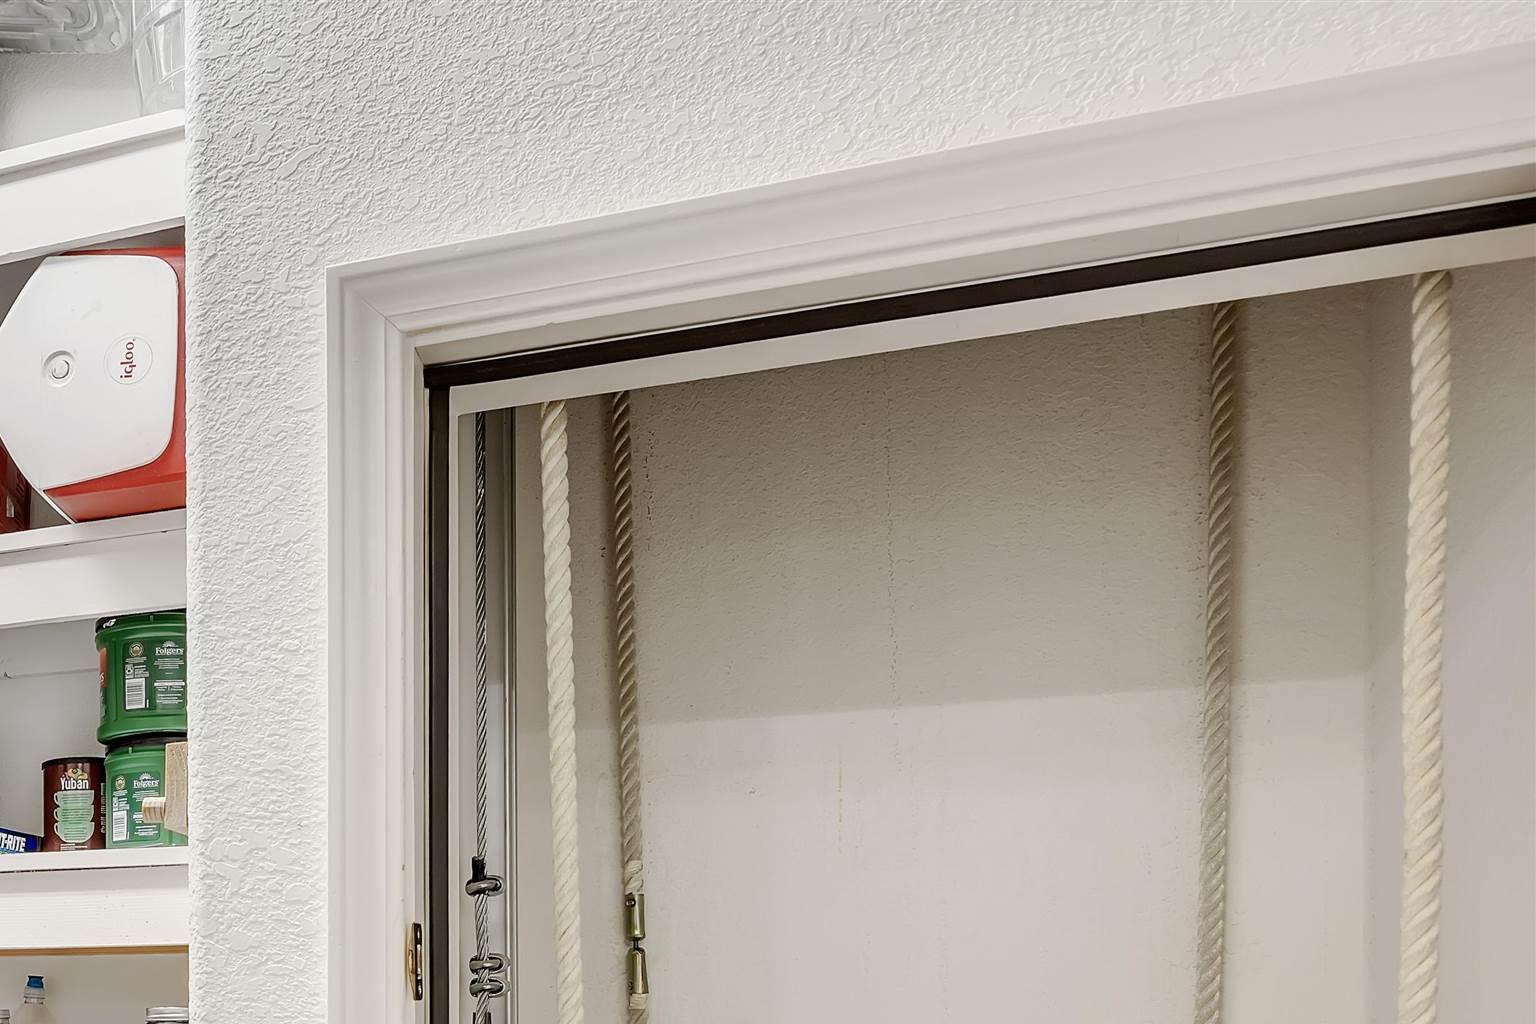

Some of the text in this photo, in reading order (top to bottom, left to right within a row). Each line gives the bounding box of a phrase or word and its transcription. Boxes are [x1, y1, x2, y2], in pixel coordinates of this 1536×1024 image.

[120, 337, 136, 380] igloo
[155, 647, 185, 656] Folgers
[60, 778, 89, 790] Yuban
[133, 780, 159, 788] Folgers
